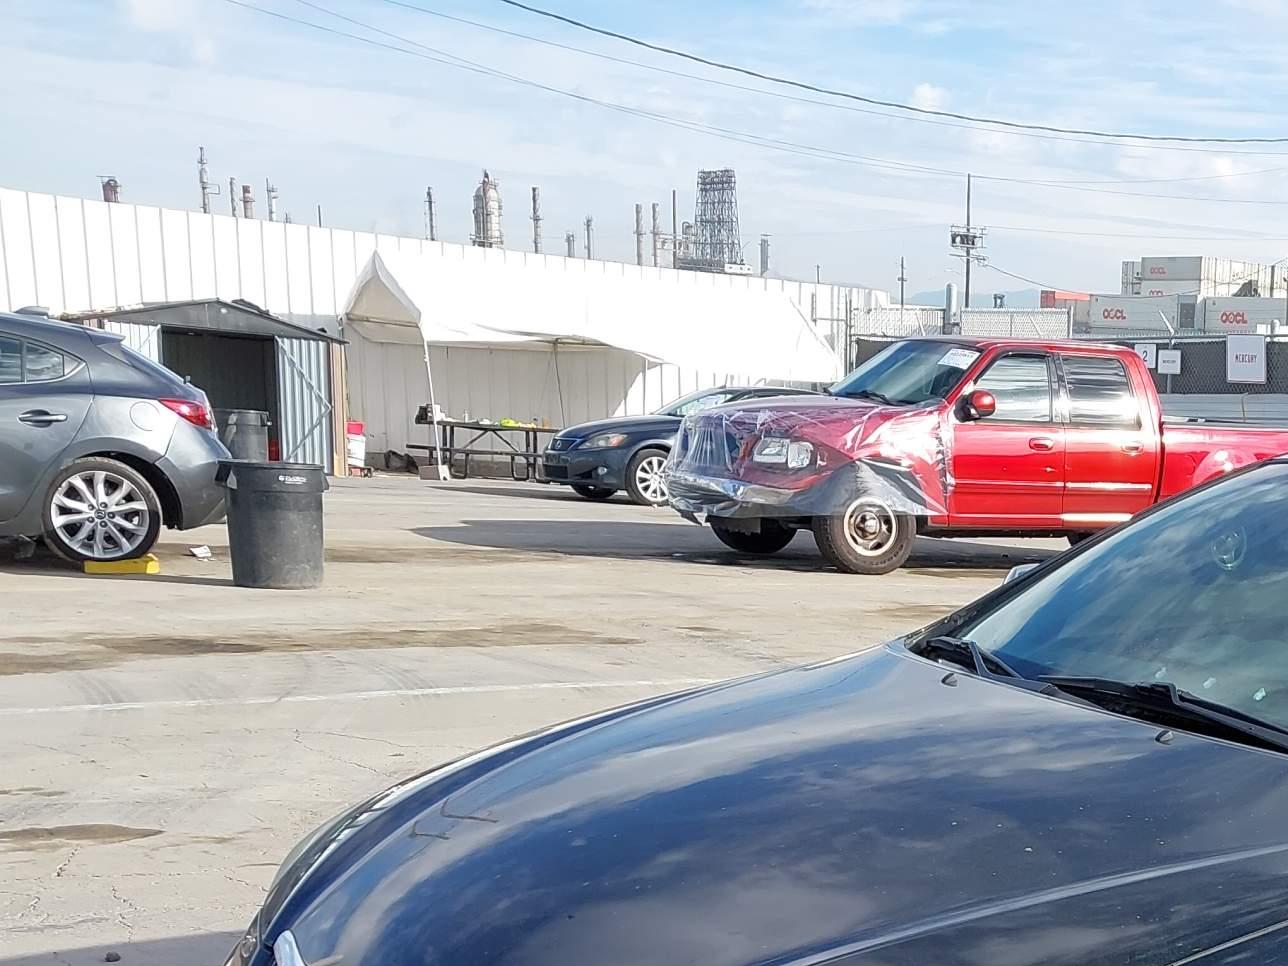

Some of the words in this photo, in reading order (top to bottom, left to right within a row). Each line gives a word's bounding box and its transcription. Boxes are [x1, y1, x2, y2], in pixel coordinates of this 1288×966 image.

[1150, 266, 1167, 275] OOCL
[1102, 308, 1127, 320] OOCL
[1220, 312, 1248, 325] OOCL
[1142, 350, 1148, 362] 2
[1235, 354, 1257, 364] MERCURY
